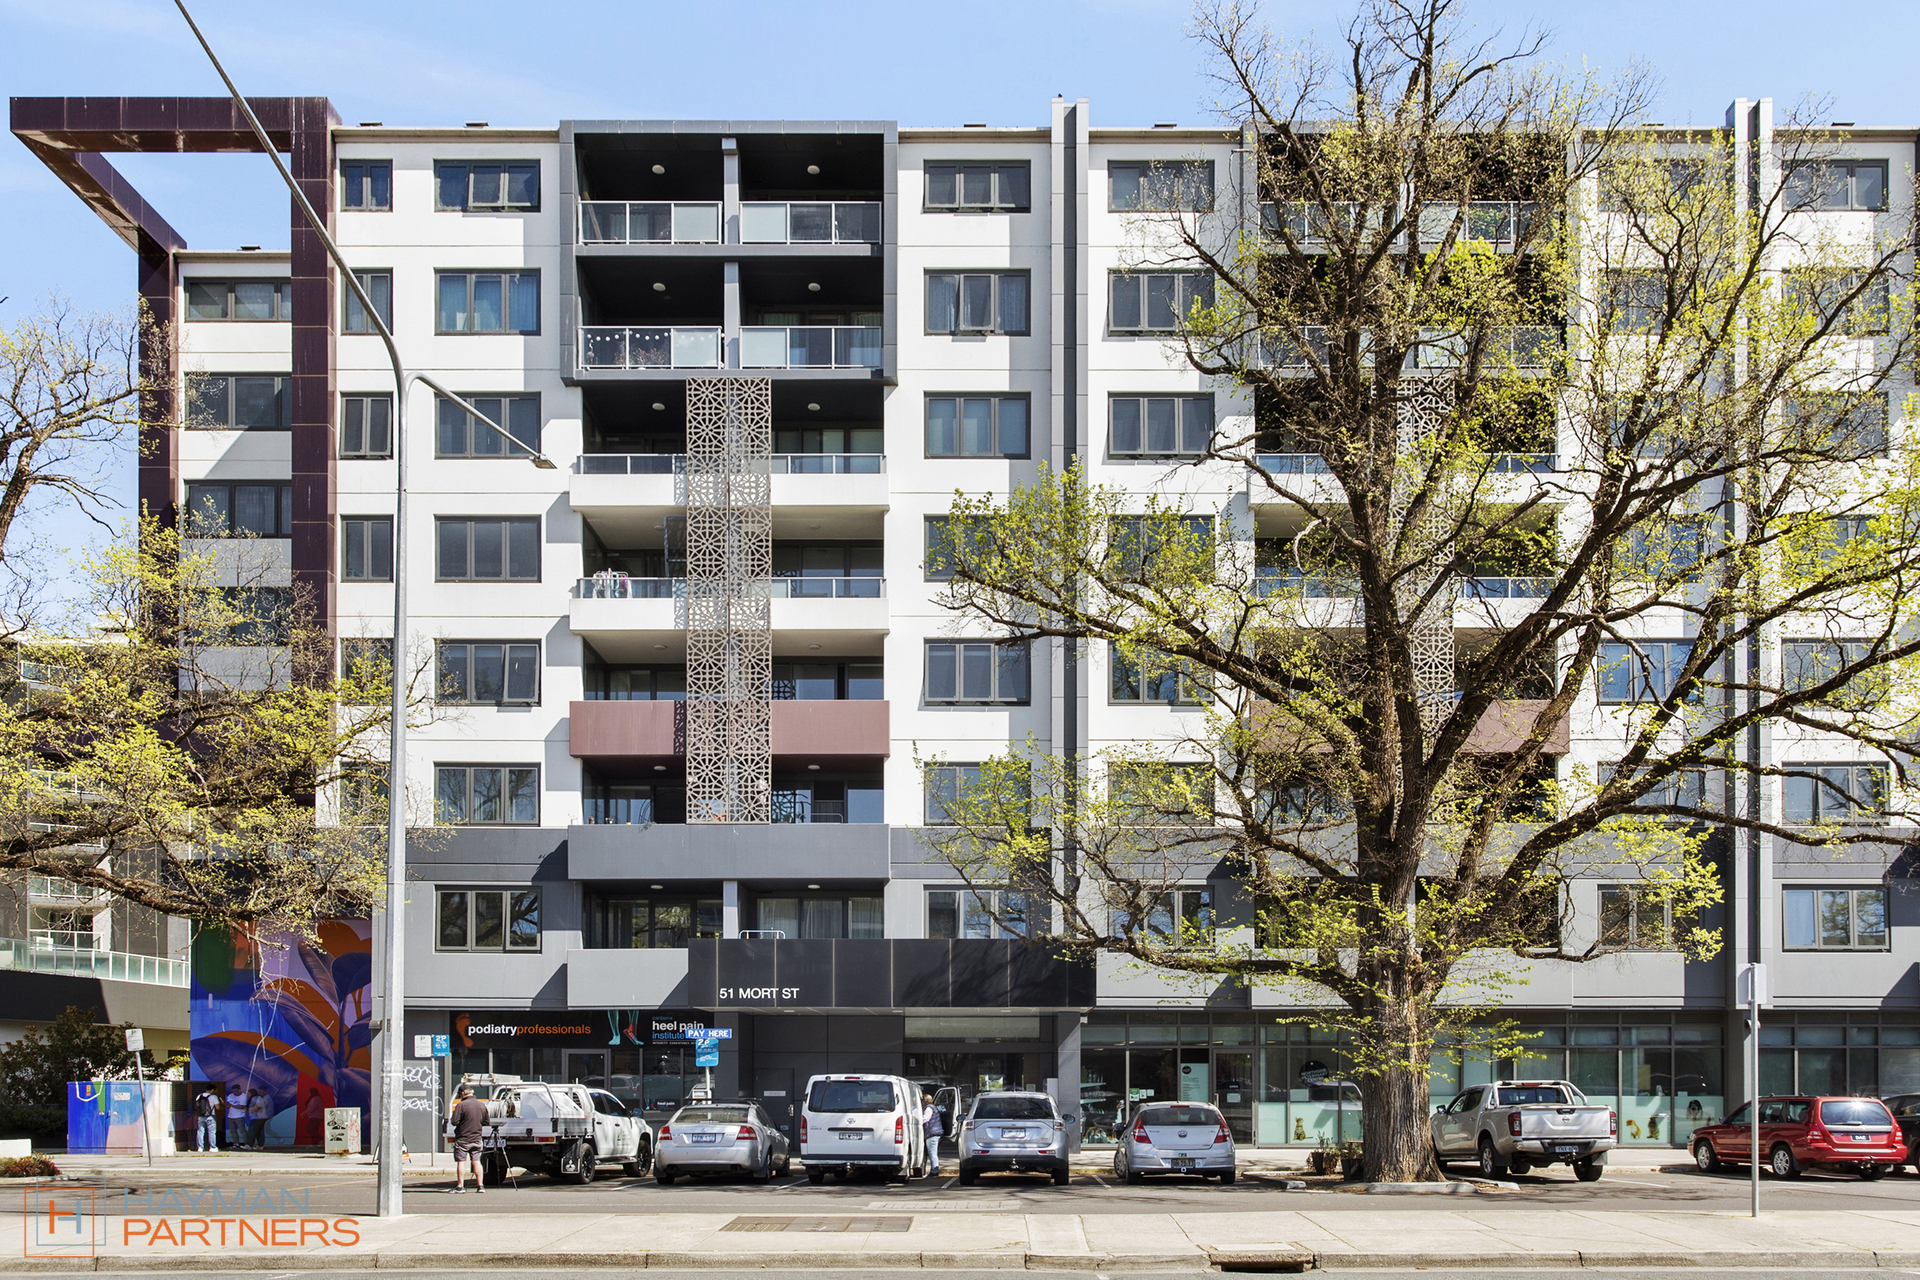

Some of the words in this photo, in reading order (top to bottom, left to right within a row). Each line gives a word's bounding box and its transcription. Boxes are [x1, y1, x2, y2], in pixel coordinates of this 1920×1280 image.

[719, 988, 734, 999] 51
[739, 988, 779, 999] MORT
[782, 988, 799, 999] ST
[652, 1021, 677, 1031] heel
[679, 1021, 704, 1033] pain
[652, 1031, 685, 1040] institute
[688, 1030, 705, 1038] PAY
[708, 1030, 729, 1038] HERE
[697, 1038, 710, 1046] 2P
